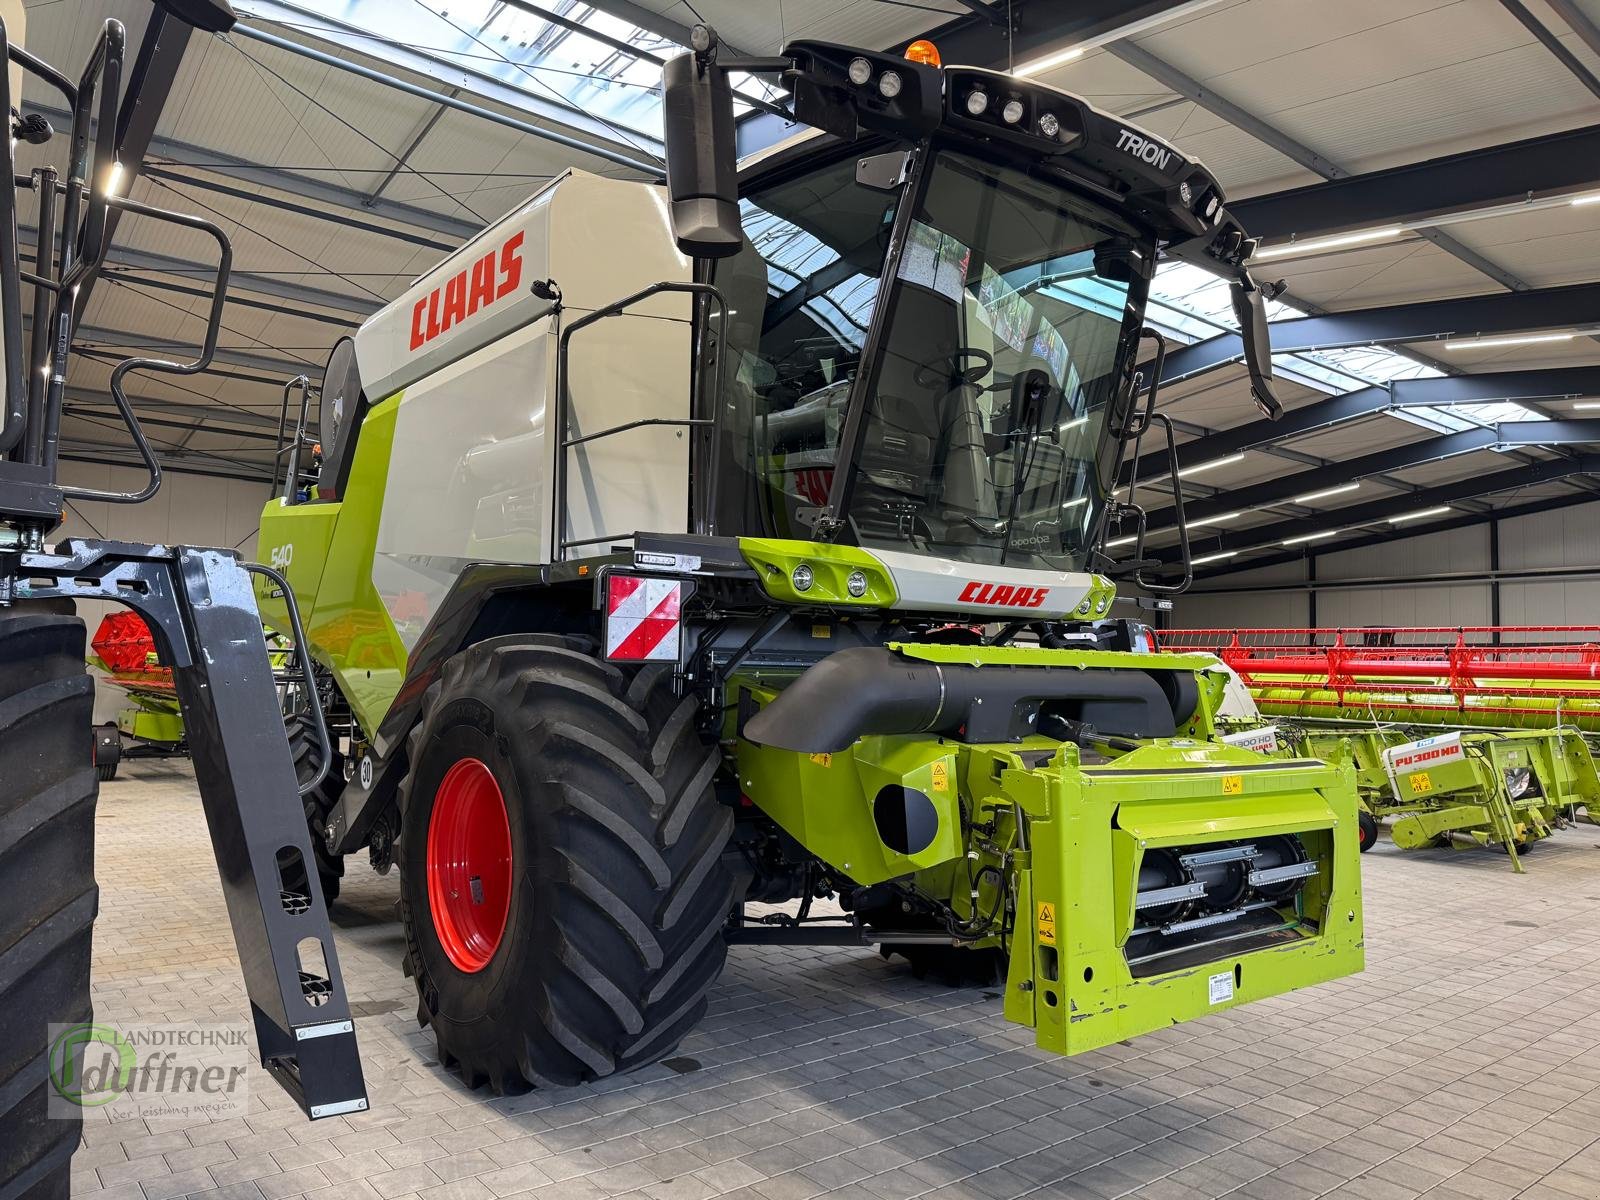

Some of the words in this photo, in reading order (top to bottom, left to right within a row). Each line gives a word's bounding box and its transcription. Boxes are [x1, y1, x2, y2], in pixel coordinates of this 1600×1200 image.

[1116, 128, 1171, 170] TRION
[409, 230, 525, 352] CLAAS
[270, 544, 293, 569] 540
[957, 581, 1050, 608] CLAAS
[362, 761, 371, 783] 30
